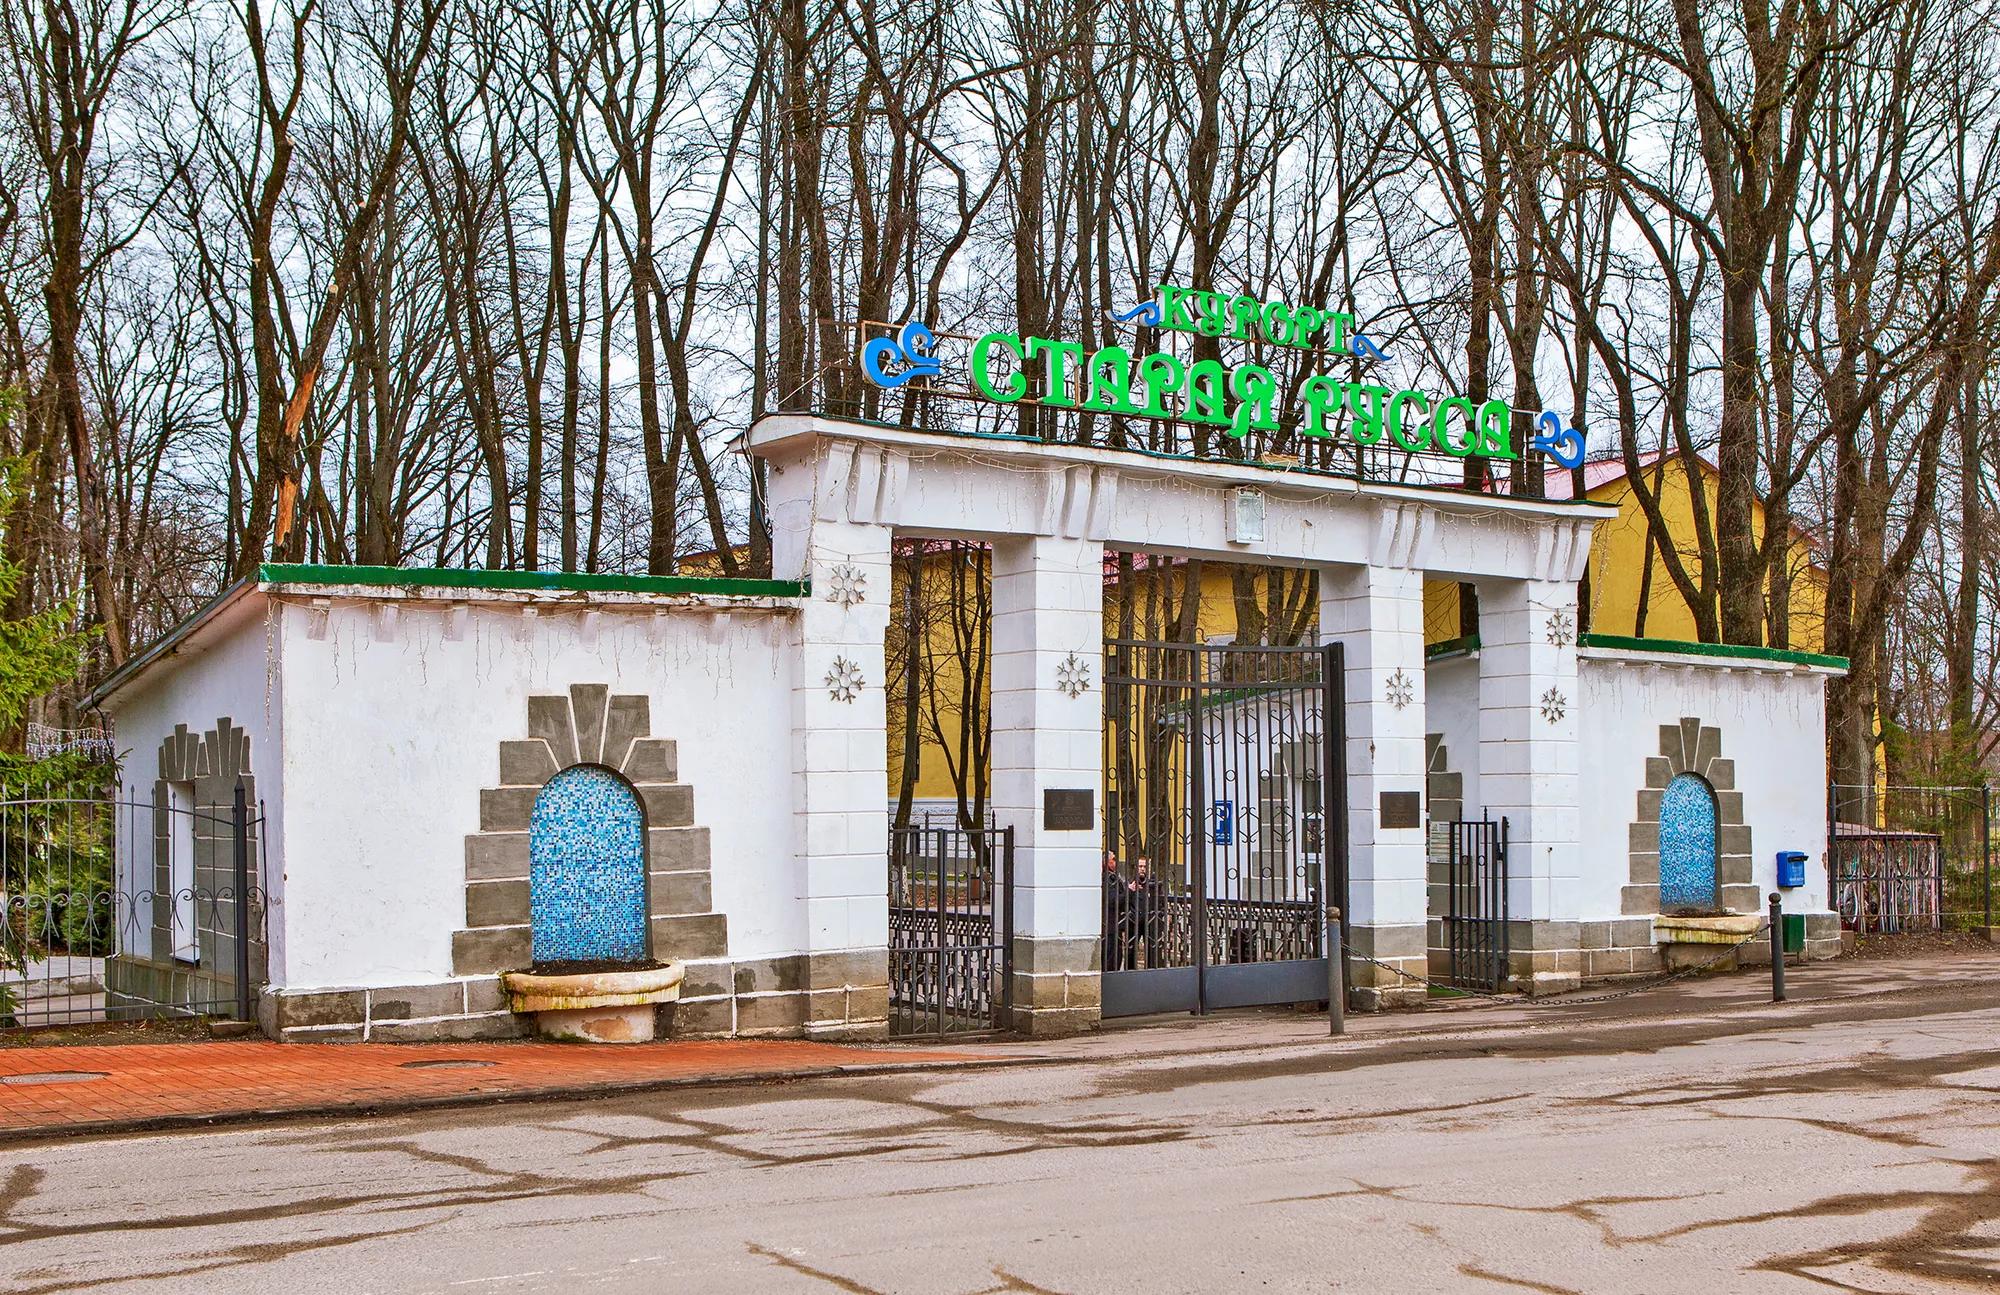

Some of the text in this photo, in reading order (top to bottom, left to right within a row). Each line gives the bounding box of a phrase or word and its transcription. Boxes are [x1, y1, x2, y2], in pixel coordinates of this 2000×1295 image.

[1154, 284, 1355, 354] КУРОРТ
[969, 332, 1518, 460] СТАРАЯ РУССА
